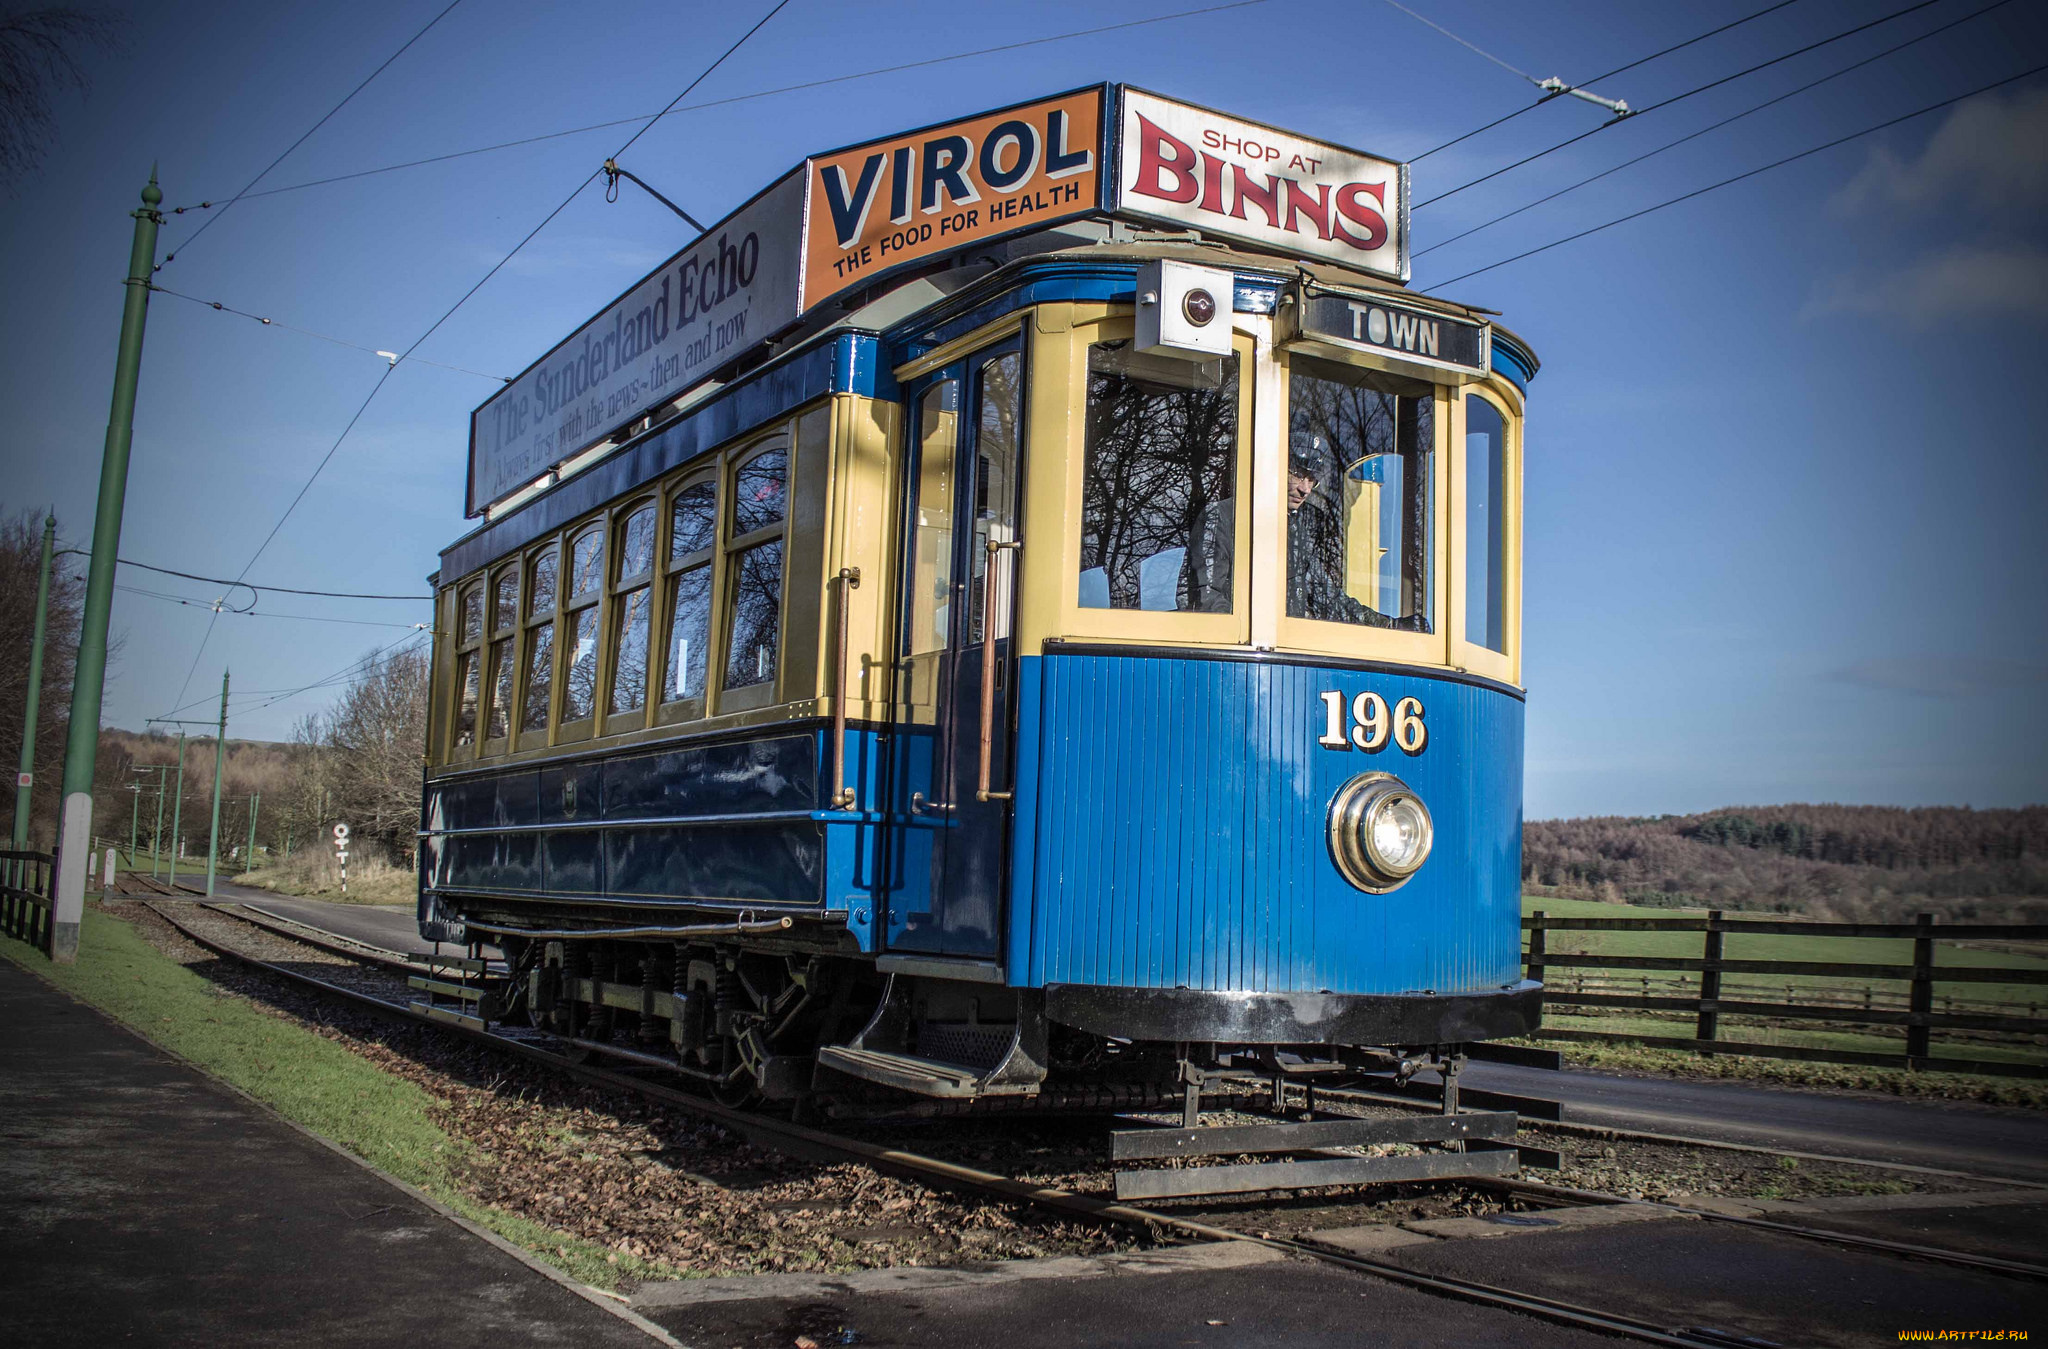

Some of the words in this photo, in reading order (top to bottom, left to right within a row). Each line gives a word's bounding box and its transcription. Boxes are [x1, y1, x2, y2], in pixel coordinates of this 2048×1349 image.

[820, 109, 1094, 250] VIROL
[1129, 110, 1388, 250] BINNS
[1202, 129, 1280, 162] SHOP
[1288, 154, 1322, 175] AT
[833, 245, 872, 278] THE
[880, 223, 932, 257] FOOD
[940, 210, 979, 236] FOR
[989, 181, 1079, 223] HEALTH
[493, 391, 529, 453] The
[533, 274, 671, 425] Sunderland
[676, 231, 760, 331] Echo
[559, 406, 582, 444] with
[586, 400, 604, 432] the
[684, 320, 711, 370] and
[1347, 301, 1439, 357] TOWN
[1318, 689, 1429, 757] 196
